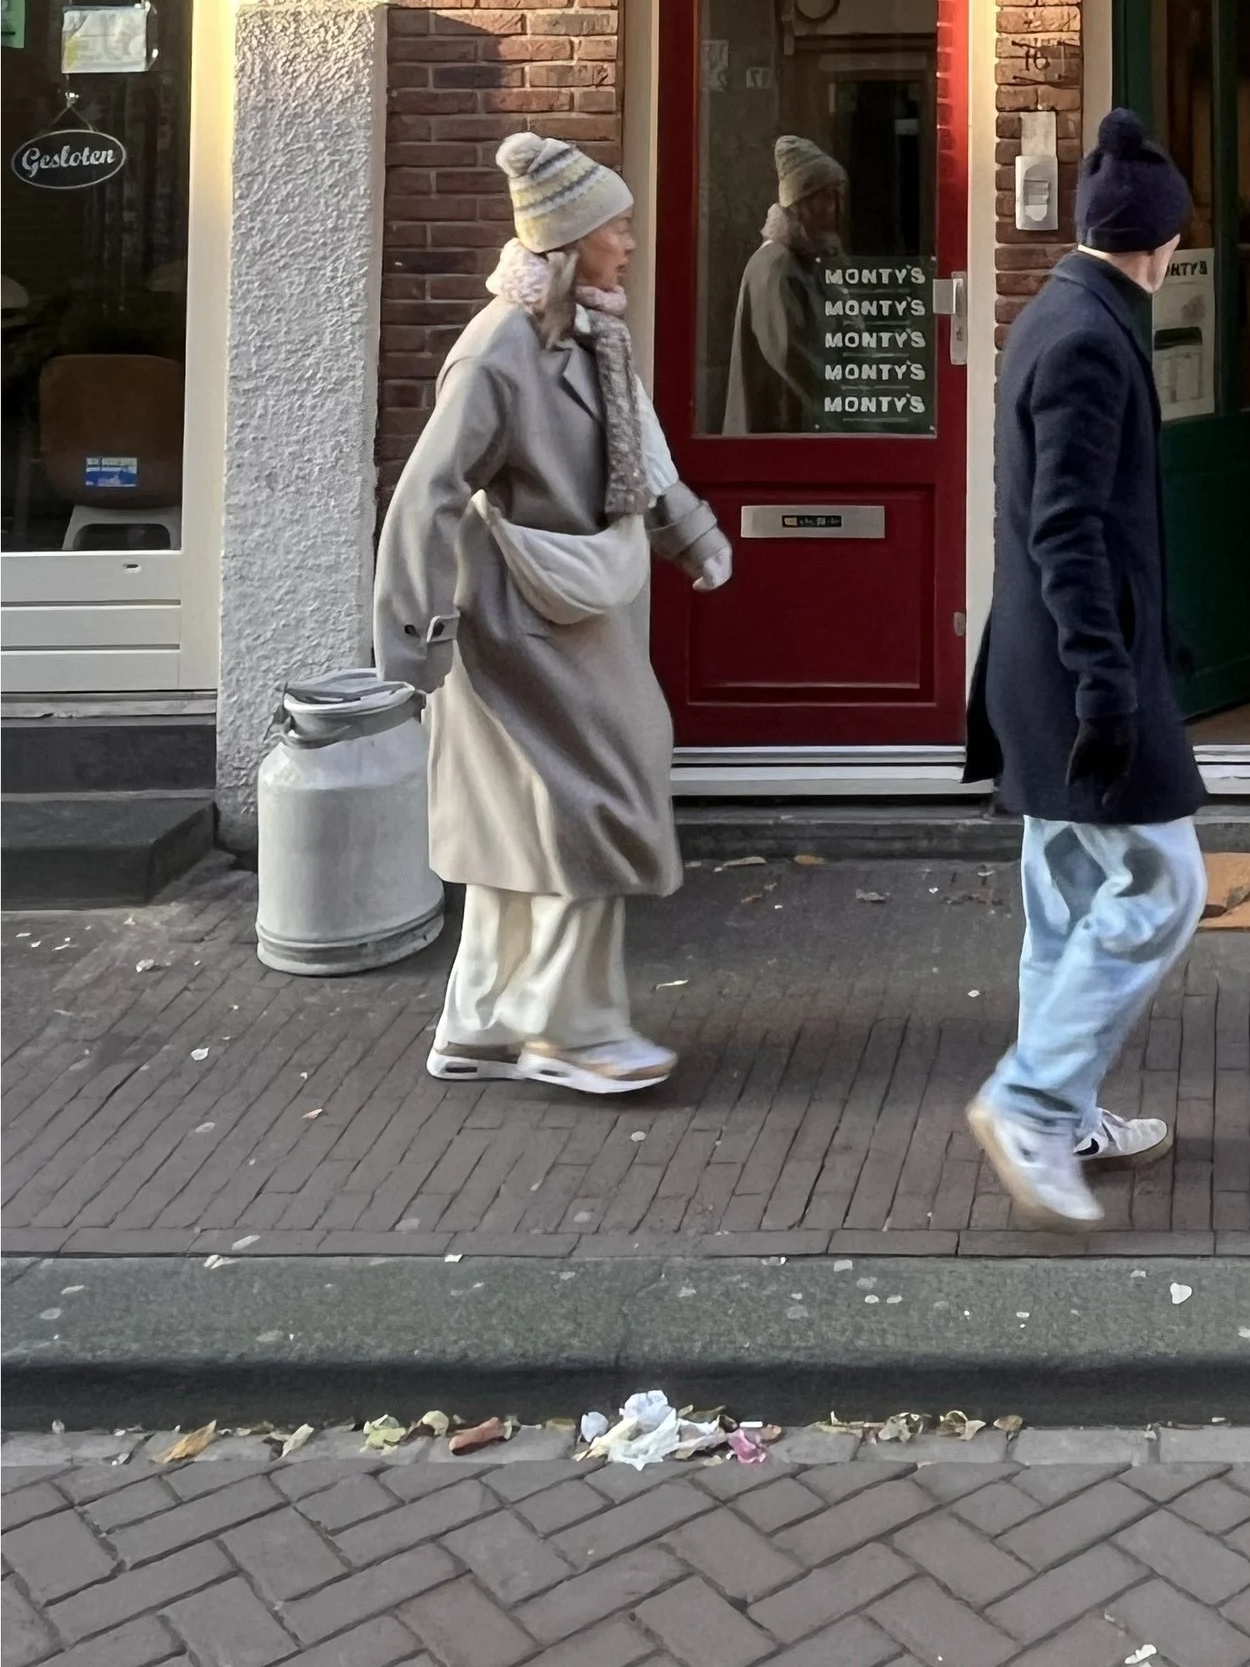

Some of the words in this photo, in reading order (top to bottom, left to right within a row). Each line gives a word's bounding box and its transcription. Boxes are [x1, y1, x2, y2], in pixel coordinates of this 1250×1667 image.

[21, 144, 115, 179] Gesloten
[825, 264, 926, 285] MONTY'S
[825, 296, 926, 316] MONTY'S
[825, 328, 926, 348] MONTY'S
[825, 360, 926, 381] MONTY'S
[824, 393, 926, 414] MONTY'S
